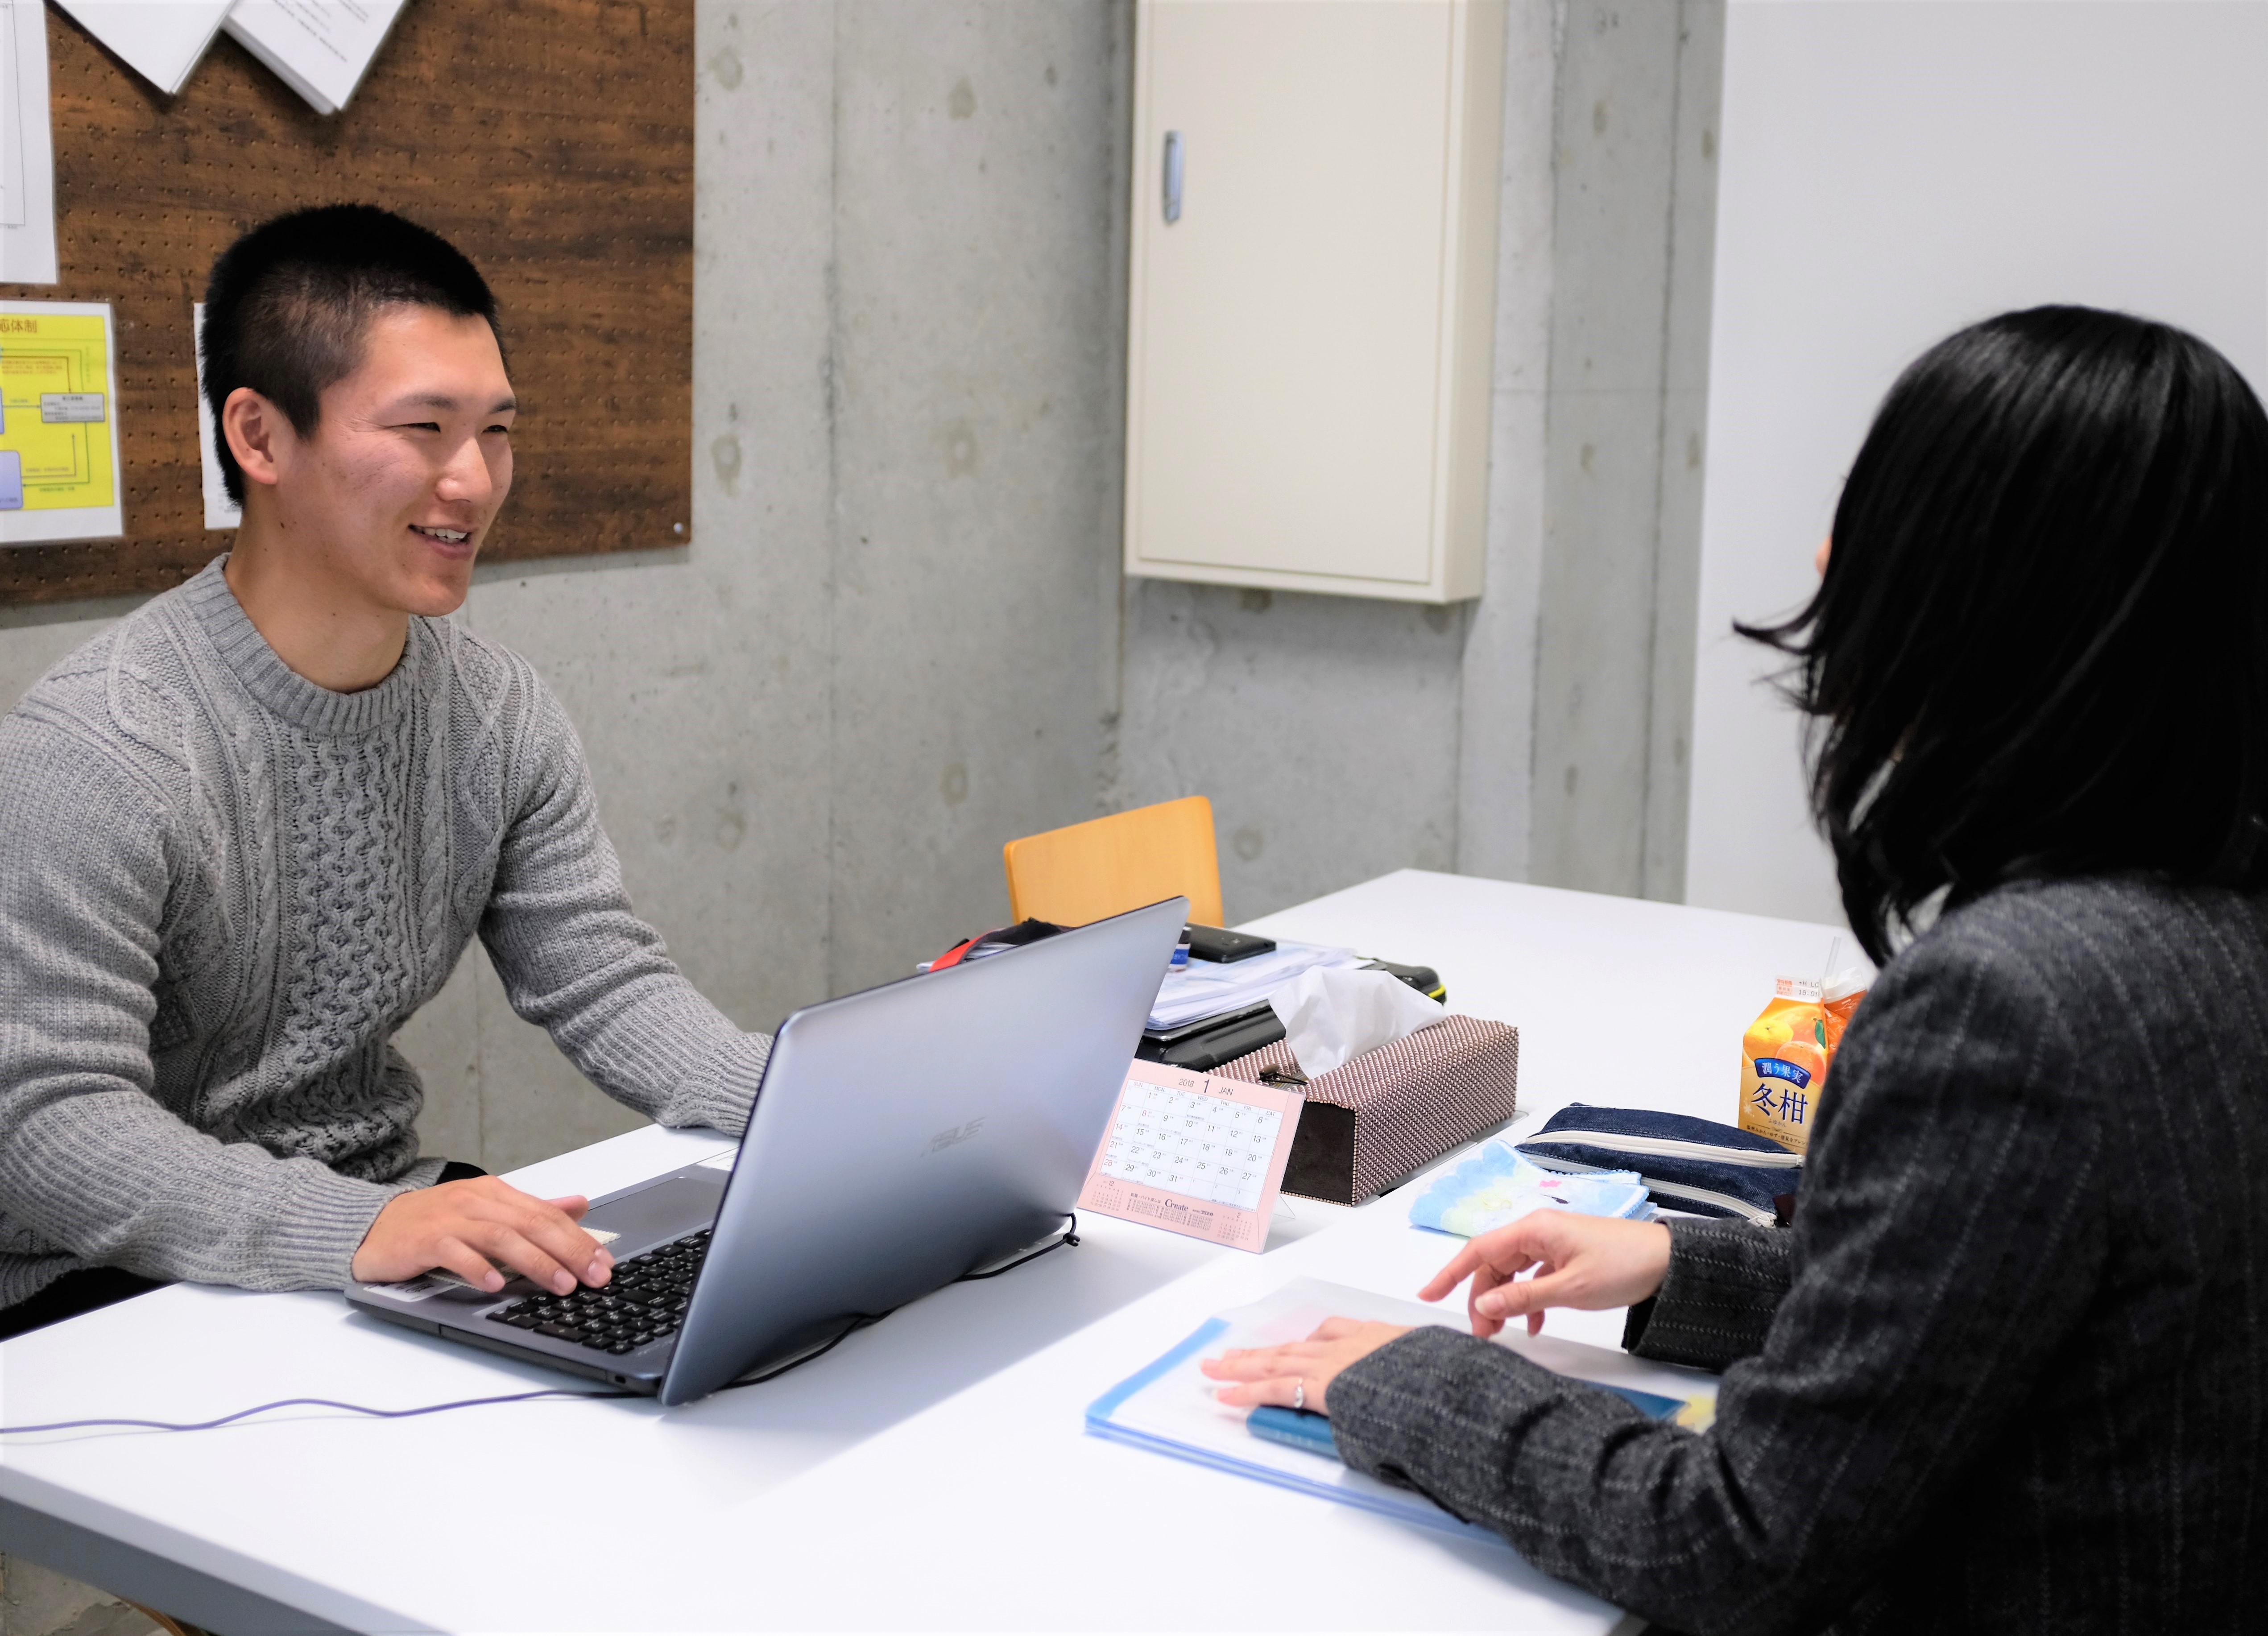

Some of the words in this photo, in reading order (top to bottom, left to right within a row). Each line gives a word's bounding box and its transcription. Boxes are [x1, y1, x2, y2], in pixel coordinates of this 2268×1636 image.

[1762, 1062, 1803, 1083] 潤う果実
[1179, 1078, 1194, 1087] 2018
[1204, 1079, 1210, 1093] 1
[1218, 1087, 1233, 1096] JAN
[1751, 1082, 1809, 1124] 冬柑
[1147, 1169, 1156, 1177] 30
[1169, 1174, 1178, 1182] 31
[1196, 1161, 1206, 1169] 25
[1219, 1167, 1229, 1175] 26
[1242, 1172, 1252, 1180] 27
[1165, 1199, 1188, 1212] Create
